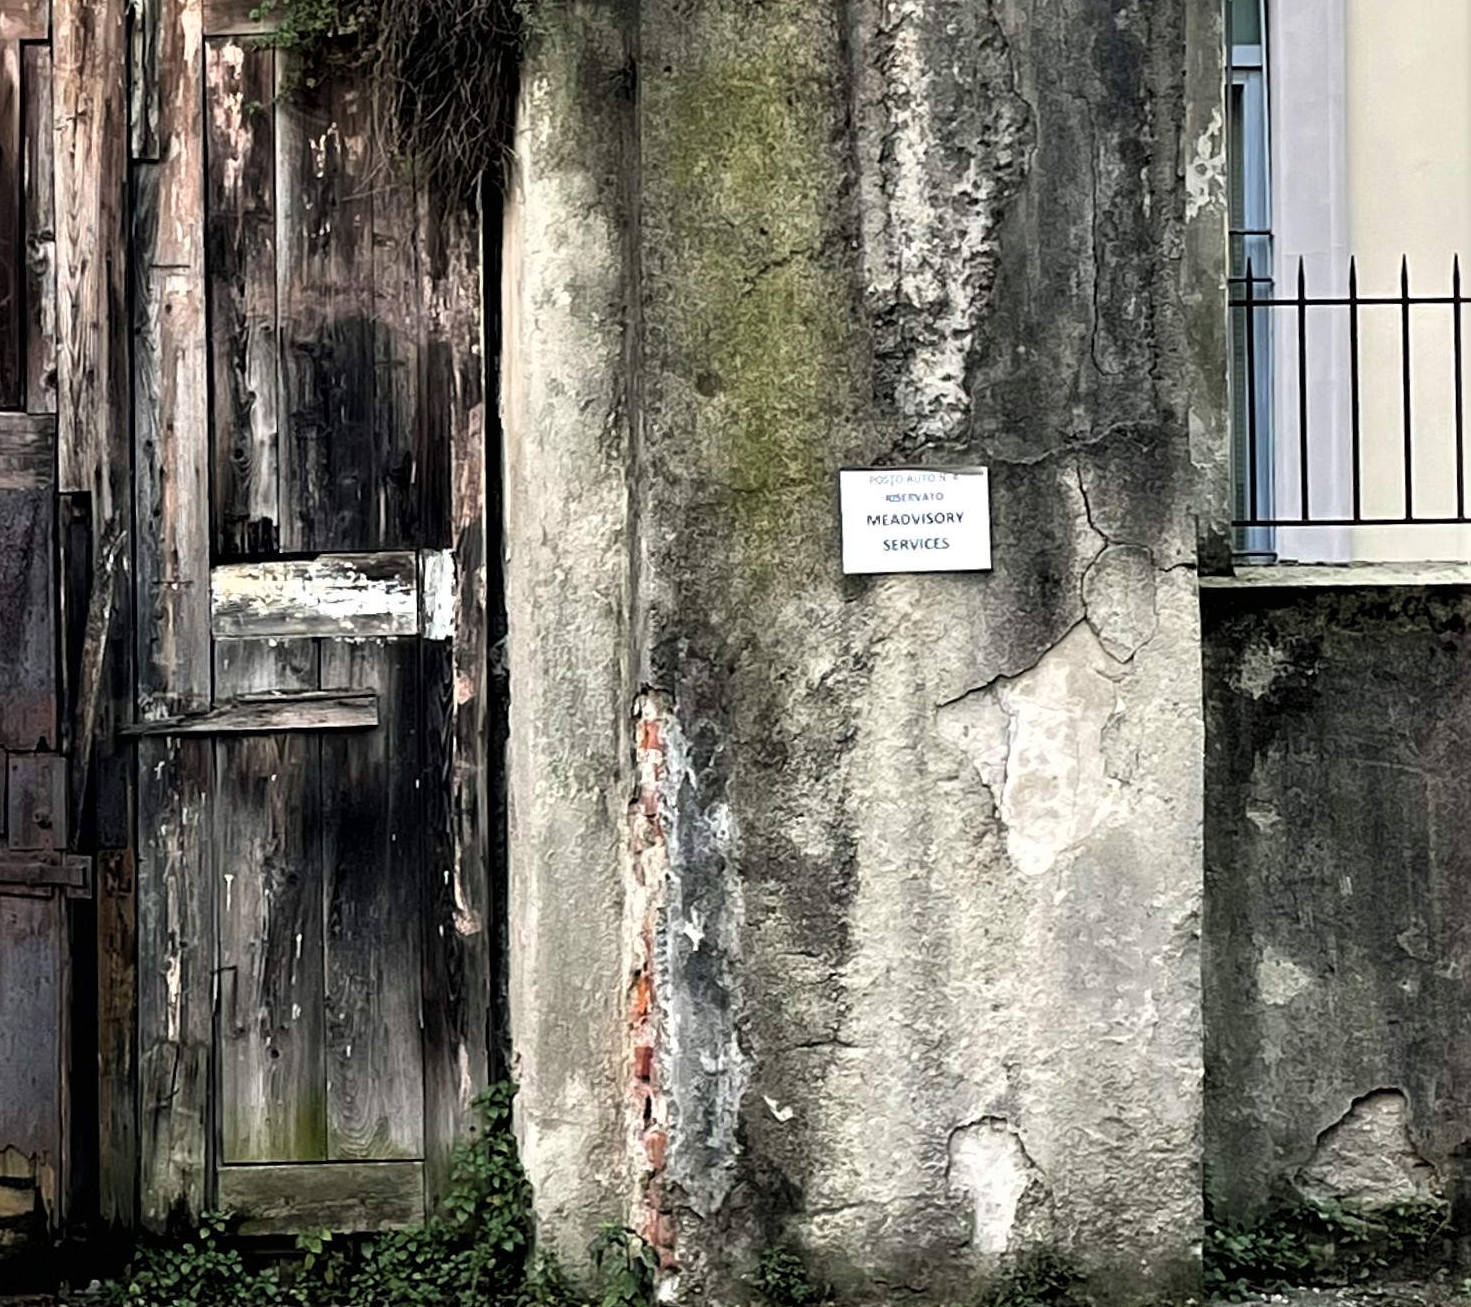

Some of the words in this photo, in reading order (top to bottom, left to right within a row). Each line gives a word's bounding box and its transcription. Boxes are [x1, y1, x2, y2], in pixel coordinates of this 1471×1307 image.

[906, 474, 935, 483] AUTO
[867, 512, 963, 526] MEADVISORY
[883, 538, 950, 551] SERVICES
